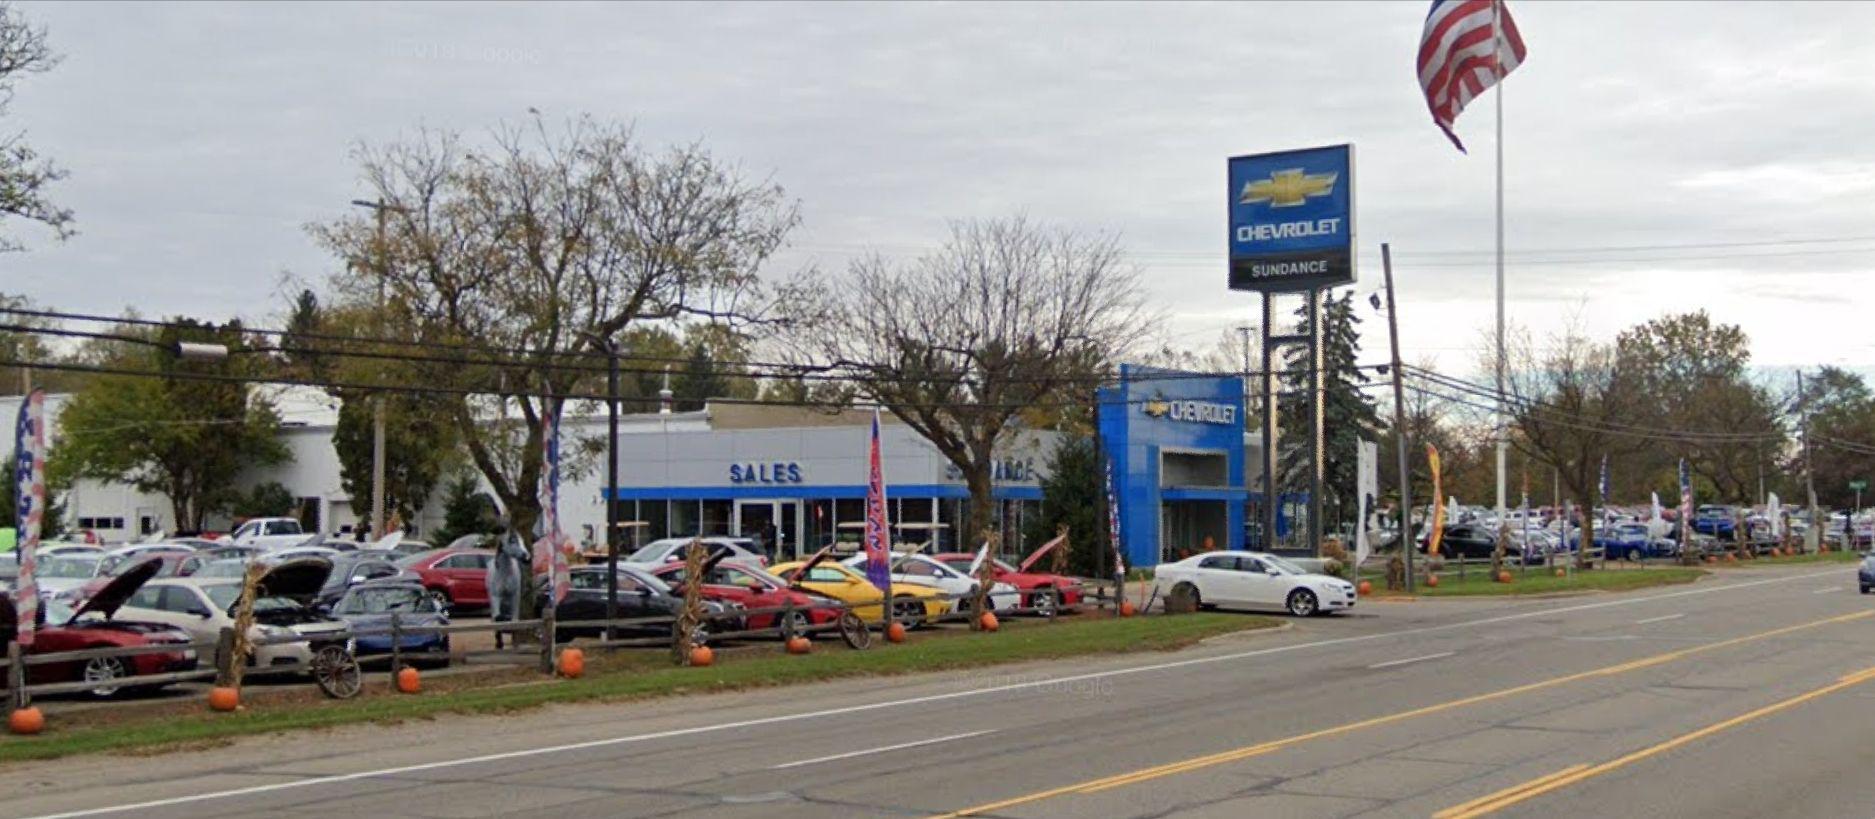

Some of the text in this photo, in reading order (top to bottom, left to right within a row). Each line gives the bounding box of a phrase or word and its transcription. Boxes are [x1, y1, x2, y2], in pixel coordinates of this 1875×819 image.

[1236, 218, 1341, 242] CHEVROLET
[1252, 260, 1328, 278] SUNDANCE
[1170, 400, 1238, 424] CHEVROLET
[729, 462, 803, 483] SALES
